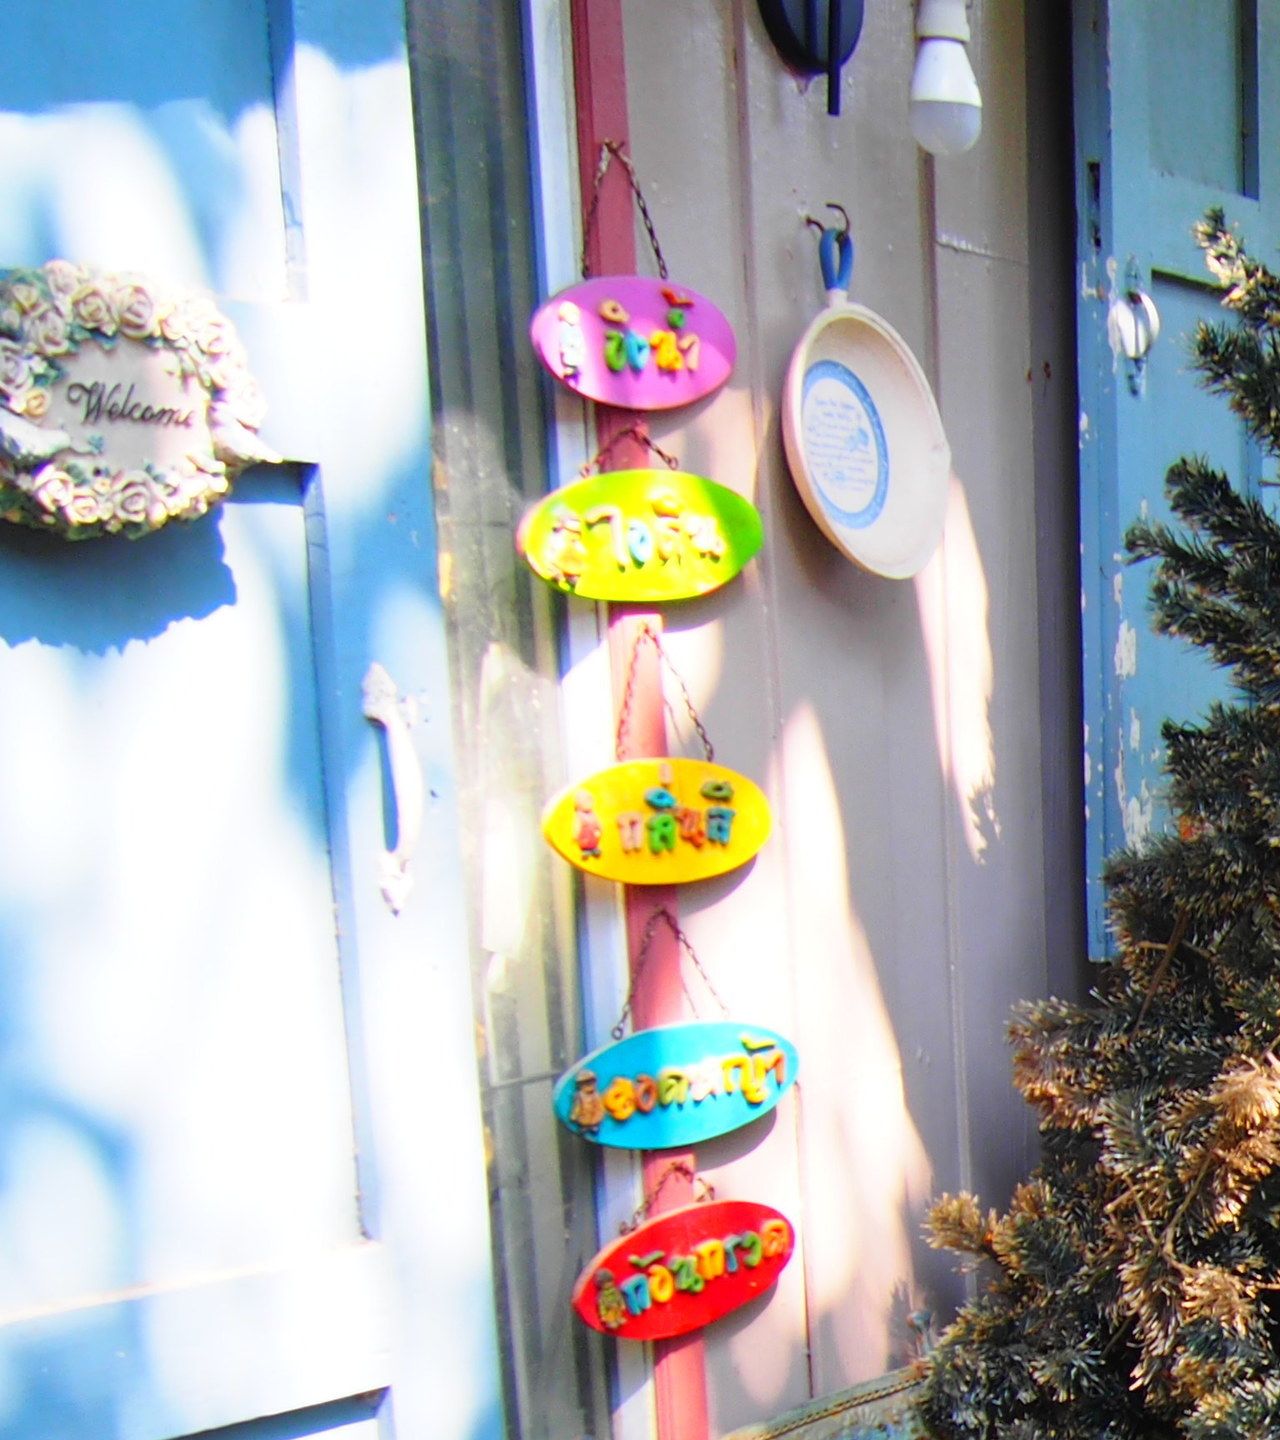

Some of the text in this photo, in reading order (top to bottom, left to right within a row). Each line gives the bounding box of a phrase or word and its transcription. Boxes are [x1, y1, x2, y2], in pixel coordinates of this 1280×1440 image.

[66, 381, 197, 428] Welcome
[603, 1035, 786, 1122] ยอดหญ้า
[620, 1218, 789, 1316] ก้อนกรวด
